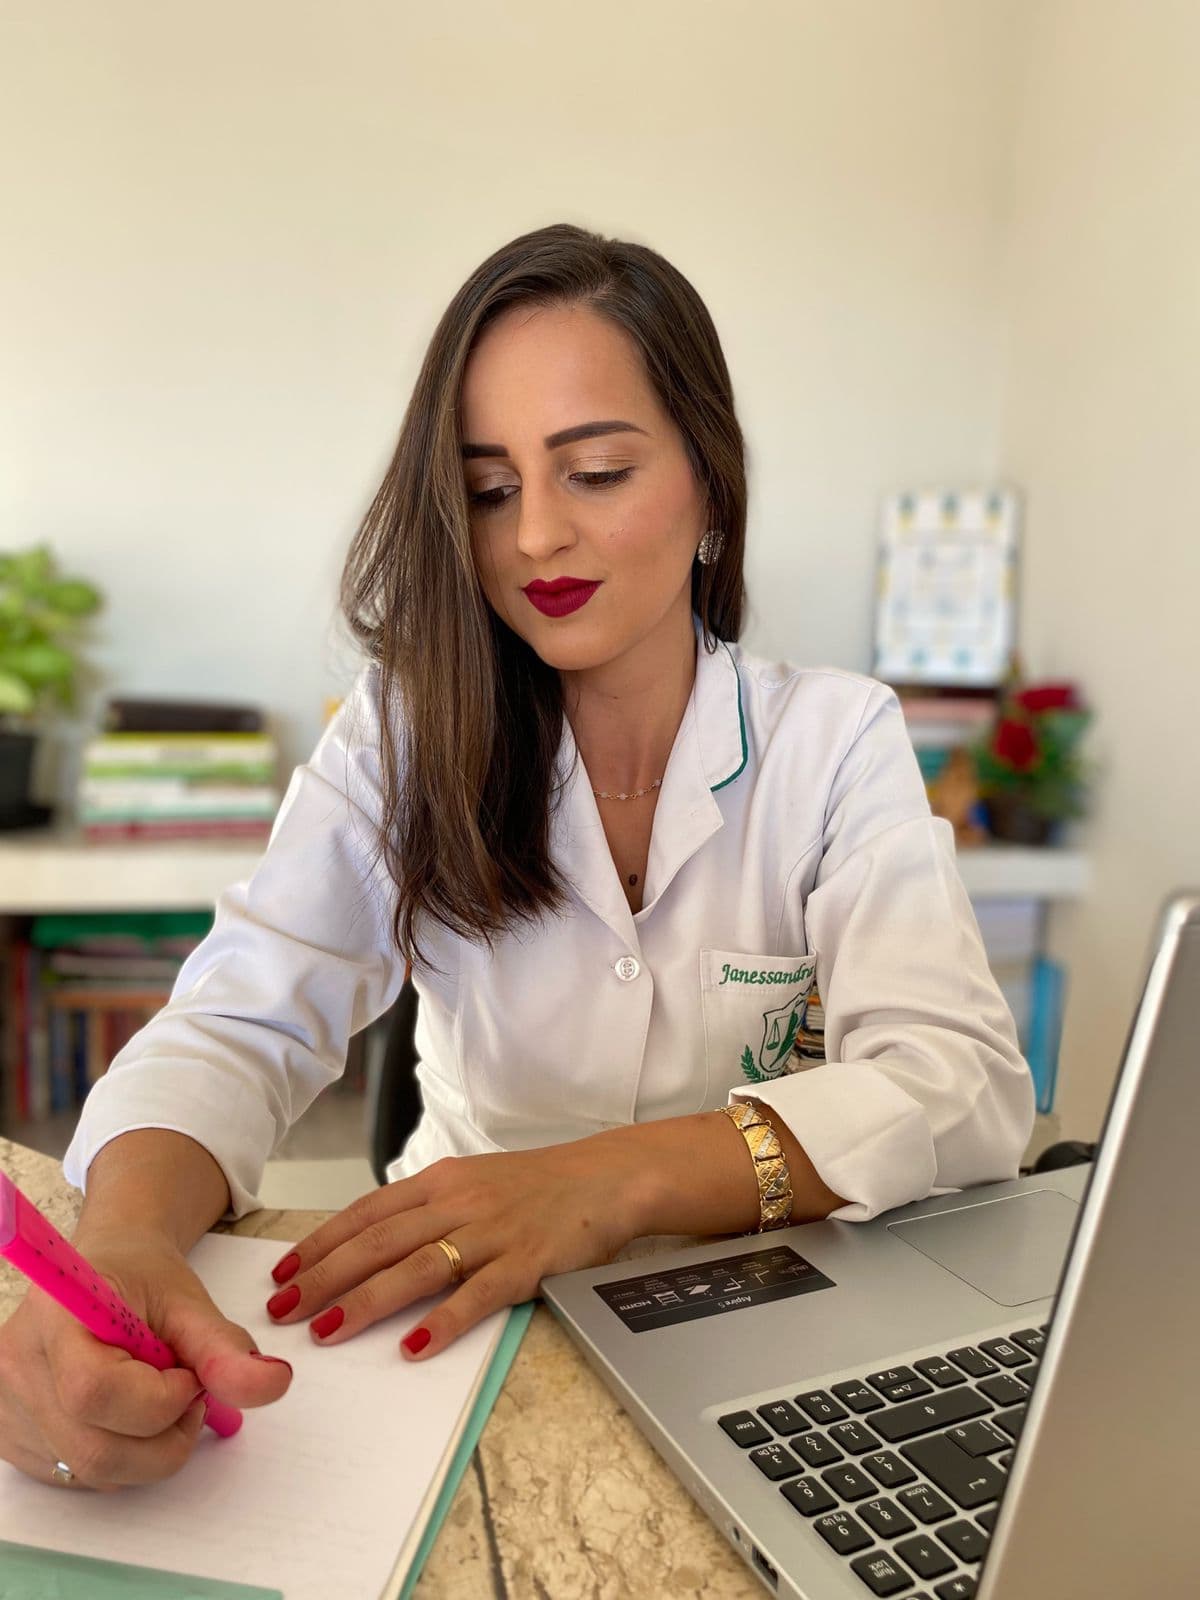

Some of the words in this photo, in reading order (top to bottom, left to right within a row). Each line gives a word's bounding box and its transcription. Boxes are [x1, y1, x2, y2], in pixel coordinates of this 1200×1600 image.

[619, 1300, 652, 1311] HDMI
[726, 1295, 751, 1306] Aspire
[771, 1406, 786, 1414] Del
[821, 1404, 831, 1412] 0
[735, 1421, 756, 1430] Enter
[839, 1423, 855, 1432] End
[850, 1431, 859, 1439] 1
[811, 1443, 822, 1451] 2
[772, 1454, 783, 1464] 3
[883, 1463, 893, 1471] 4
[844, 1474, 856, 1484] 5
[803, 1488, 814, 1498] 6
[906, 1487, 929, 1497] Home
[922, 1496, 933, 1506] 7
[832, 1514, 847, 1522] Pg
[880, 1510, 892, 1520] 8
[822, 1518, 837, 1526] Up
[838, 1525, 849, 1535] 9
[868, 1560, 891, 1571] Lock
[873, 1567, 896, 1578] Num
